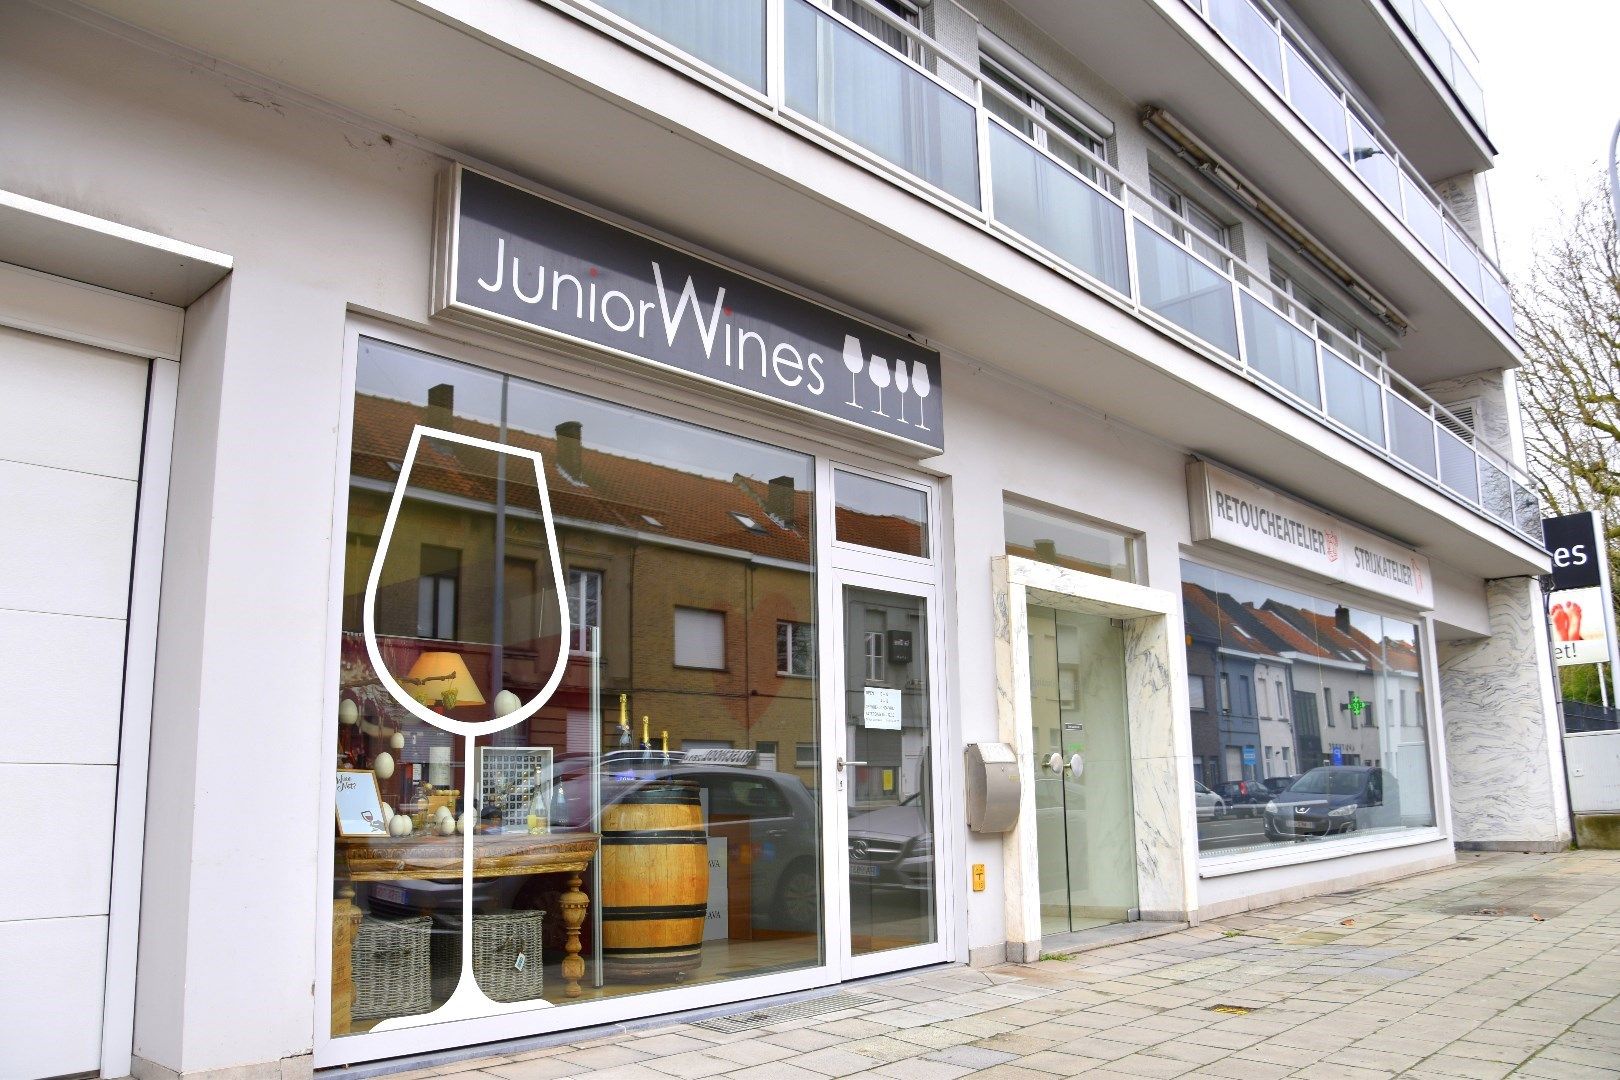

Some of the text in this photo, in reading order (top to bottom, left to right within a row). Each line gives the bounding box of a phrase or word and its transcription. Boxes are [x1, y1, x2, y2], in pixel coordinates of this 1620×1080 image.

[1215, 490, 1327, 556] RETOUCHEATELIER
[1354, 546, 1414, 587] STRIJKATELIER
[705, 910, 721, 920] AVA
